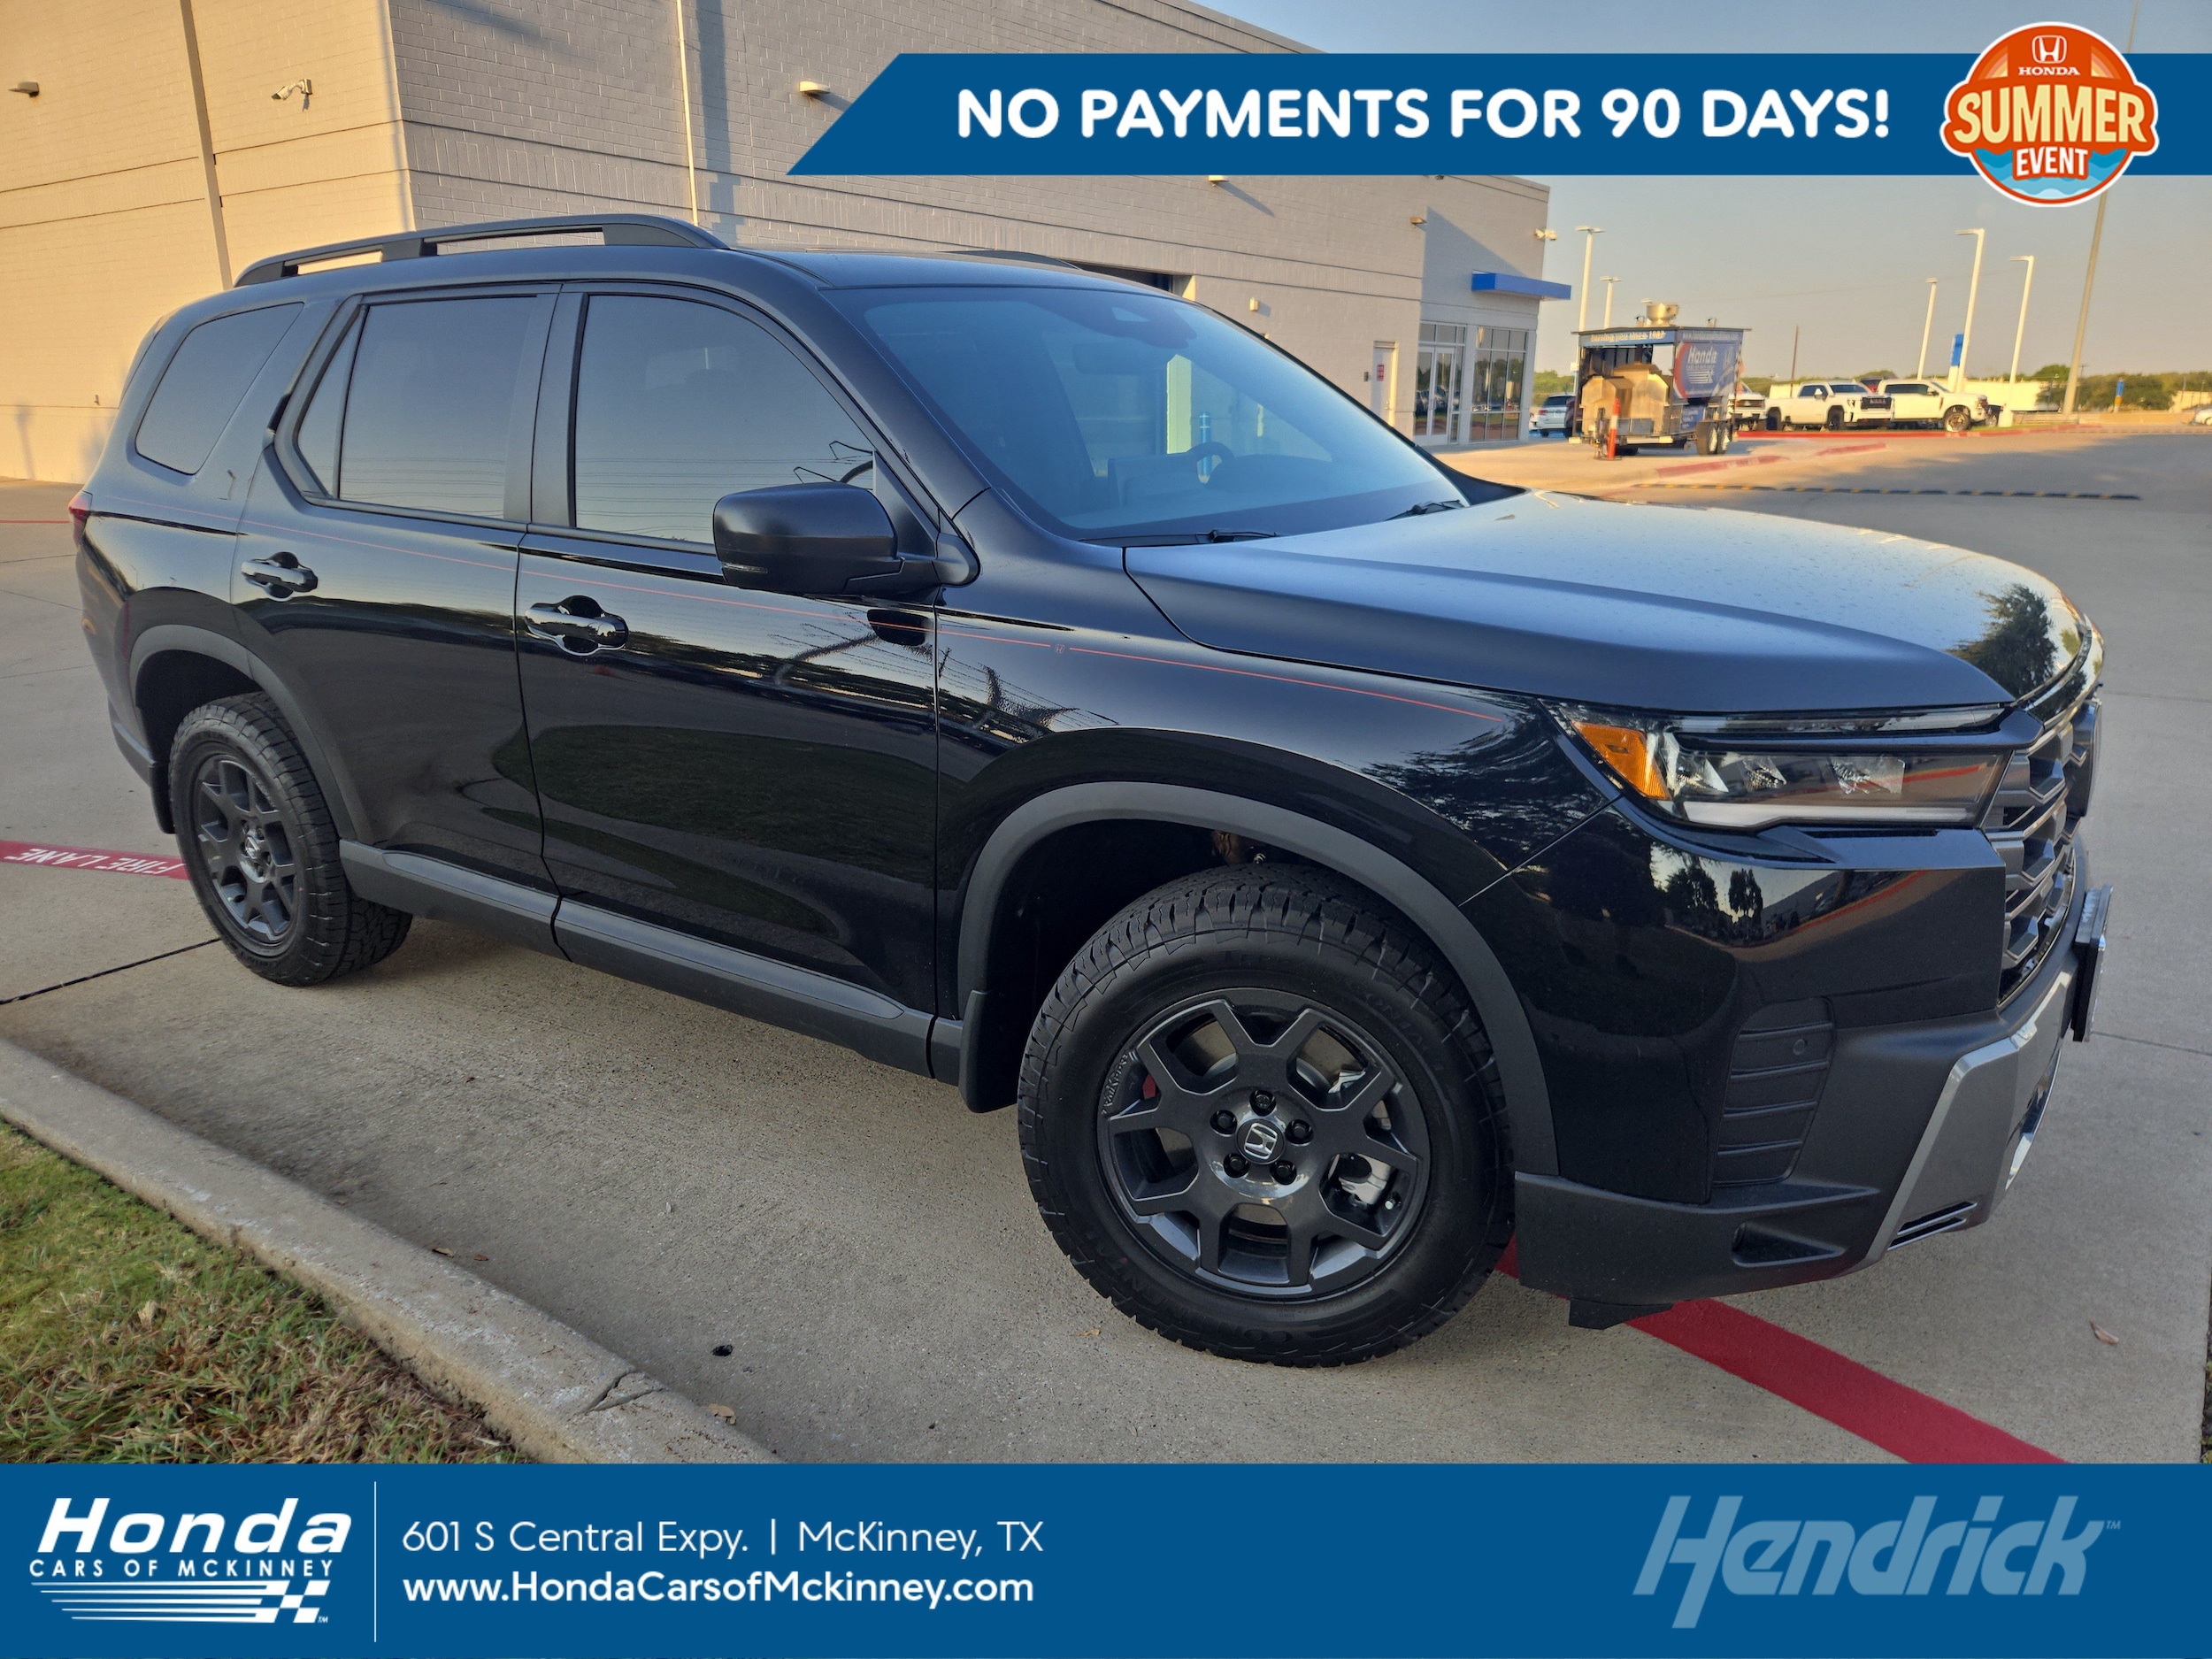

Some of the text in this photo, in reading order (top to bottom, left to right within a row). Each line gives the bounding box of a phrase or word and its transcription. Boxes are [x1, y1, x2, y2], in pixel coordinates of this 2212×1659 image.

[1687, 345, 1717, 365] Honda
[4, 848, 186, 875] FIRE LANE
